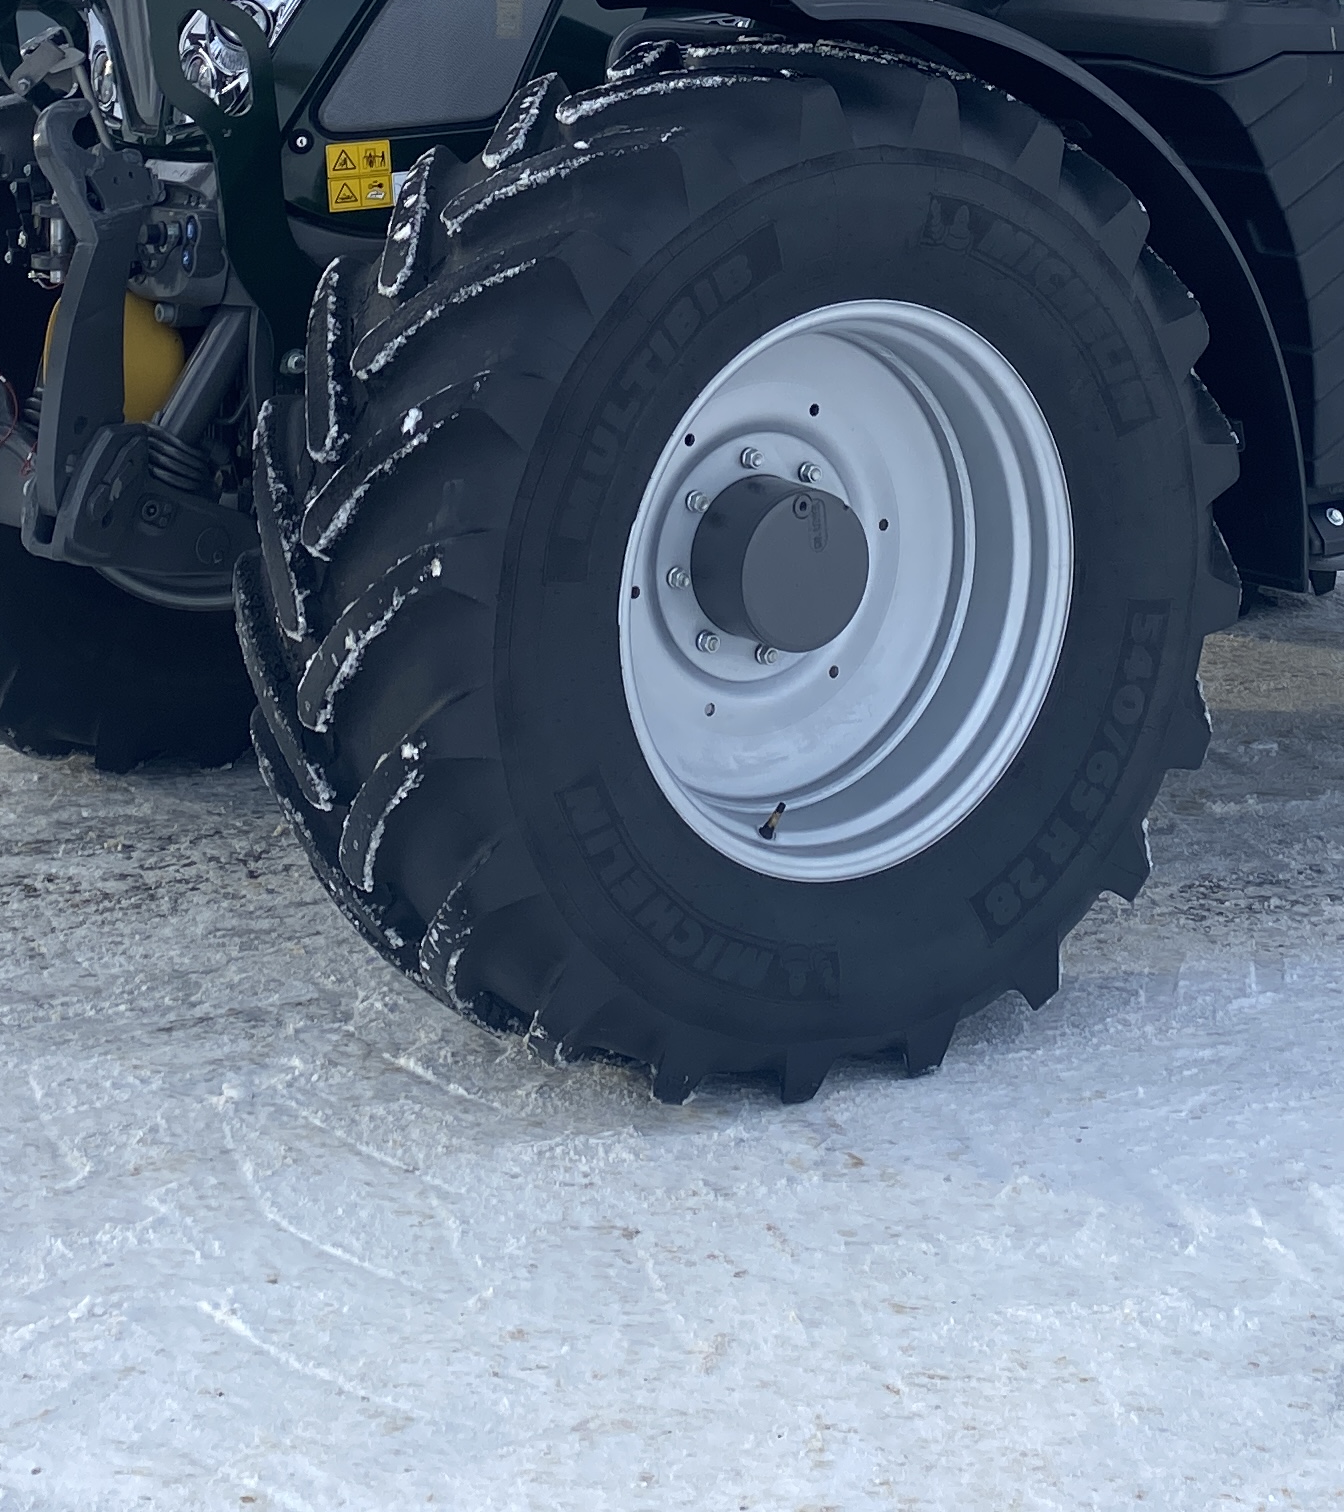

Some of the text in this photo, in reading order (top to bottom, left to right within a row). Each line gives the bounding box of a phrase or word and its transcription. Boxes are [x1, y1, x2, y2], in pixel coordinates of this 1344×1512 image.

[559, 253, 752, 541] MULTIBIB
[978, 219, 1152, 422] MICHELIN
[565, 787, 774, 988] MICHELIN
